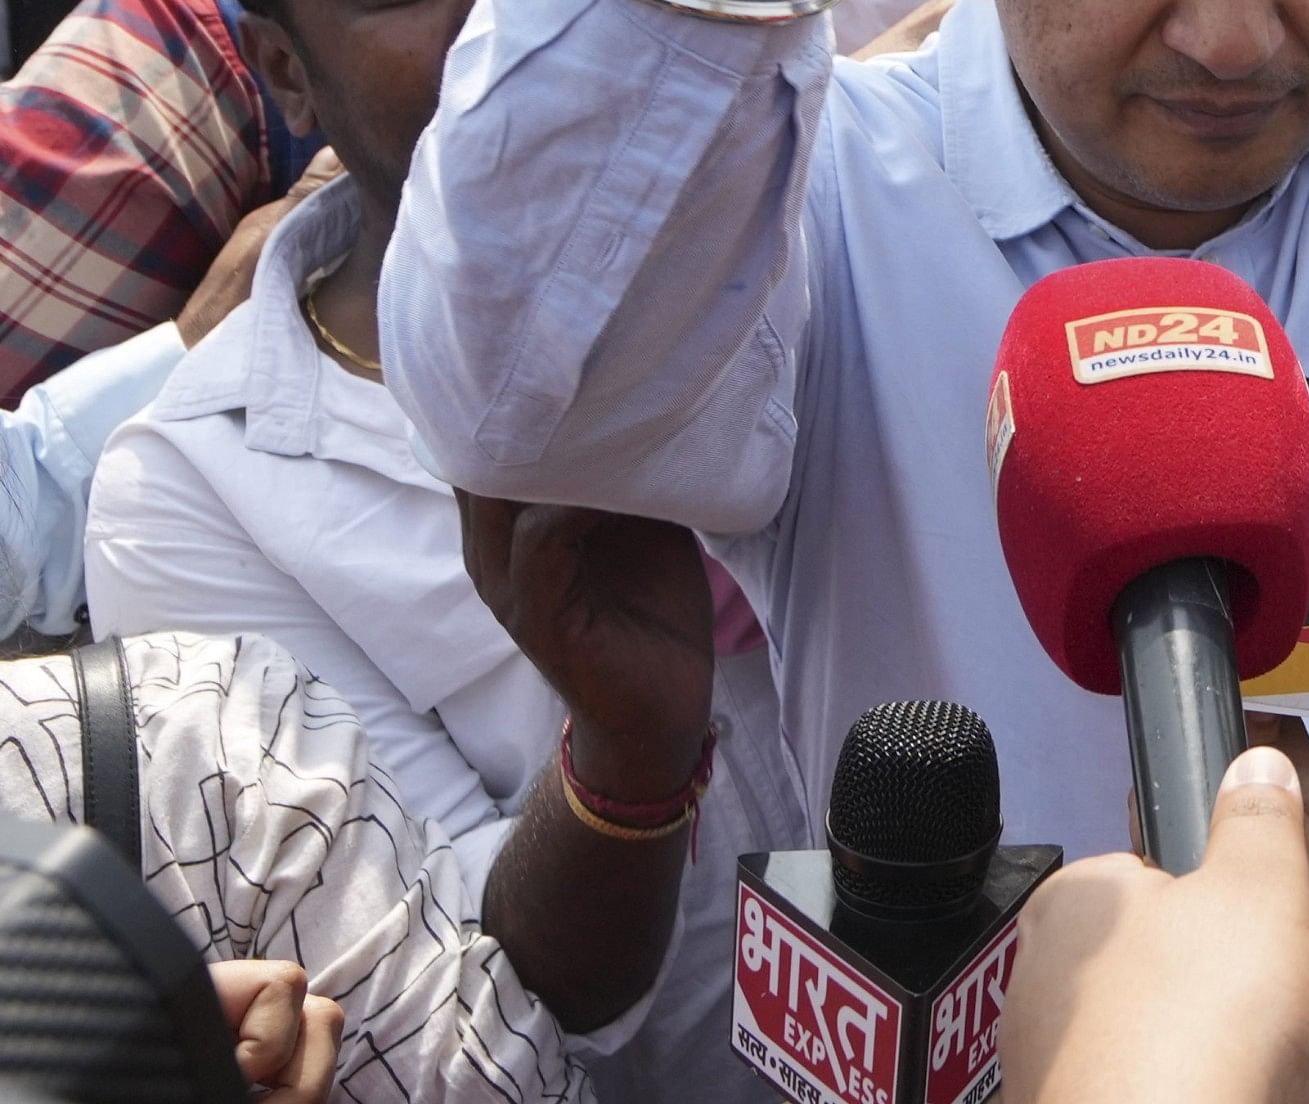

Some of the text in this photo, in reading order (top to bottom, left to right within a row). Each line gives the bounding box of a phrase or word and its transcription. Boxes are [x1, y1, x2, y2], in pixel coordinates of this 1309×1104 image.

[1093, 313, 1239, 353] ND24
[1090, 346, 1257, 372] newsdaily24.in
[741, 898, 888, 1094] भारत
[737, 1022, 768, 1067] सत्य
